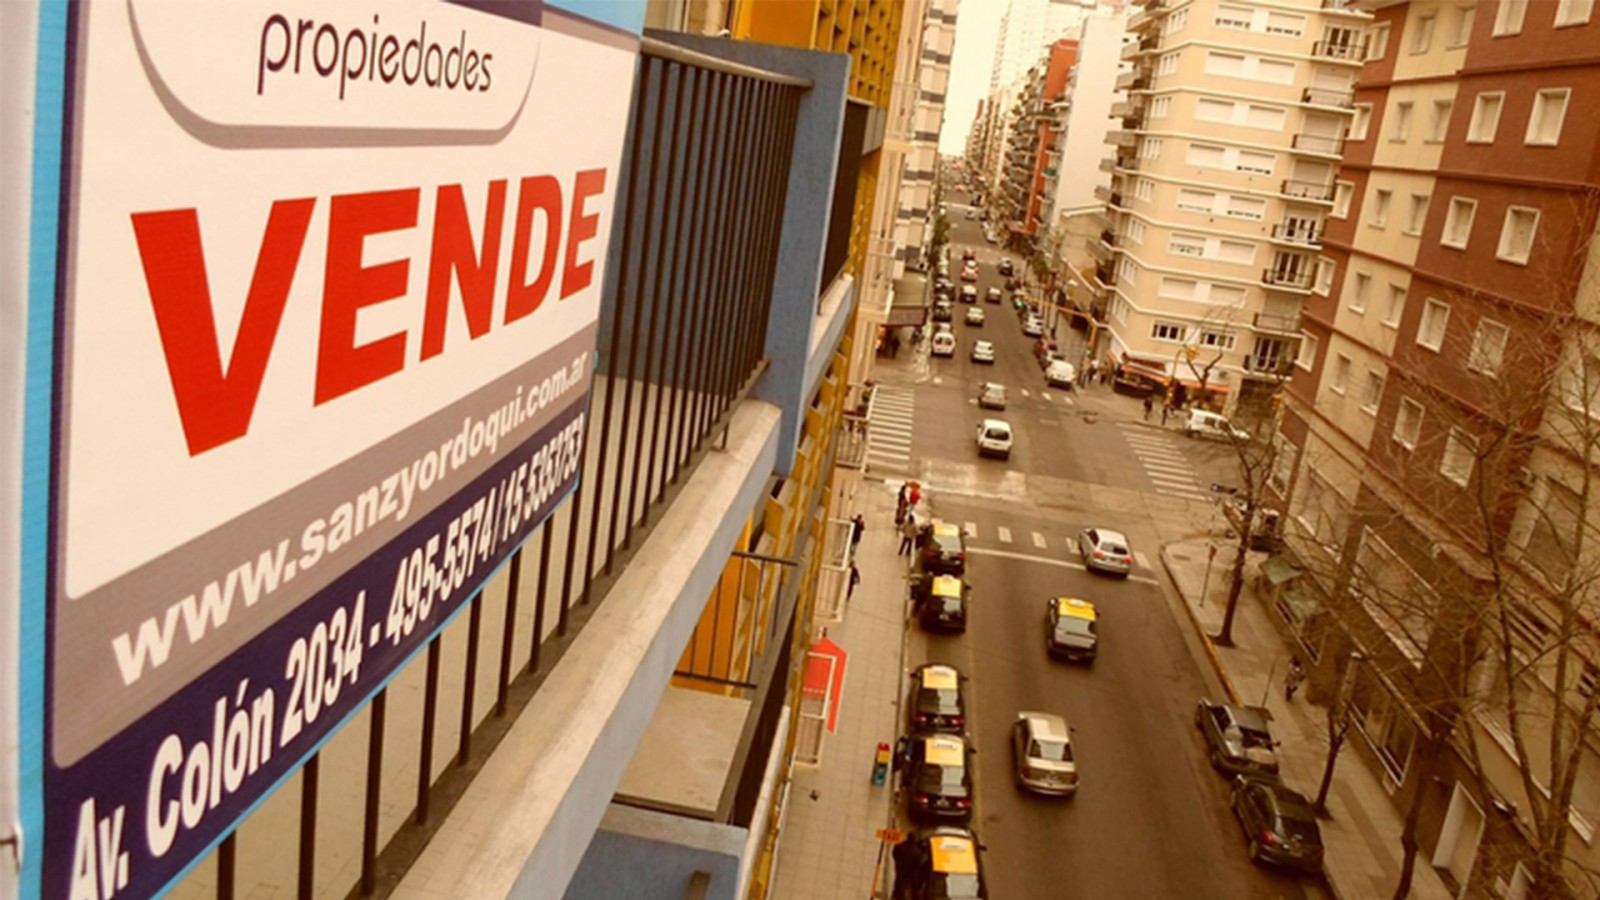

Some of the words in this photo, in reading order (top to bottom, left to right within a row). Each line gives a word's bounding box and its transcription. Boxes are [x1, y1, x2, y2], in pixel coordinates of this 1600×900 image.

[257, 13, 493, 99] propiedades
[130, 167, 608, 457] VENDE
[111, 350, 589, 686] www.sanzyordoqui.com.ar
[68, 797, 129, 900] Av.
[146, 678, 275, 858] Colón
[280, 590, 366, 748] 2034
